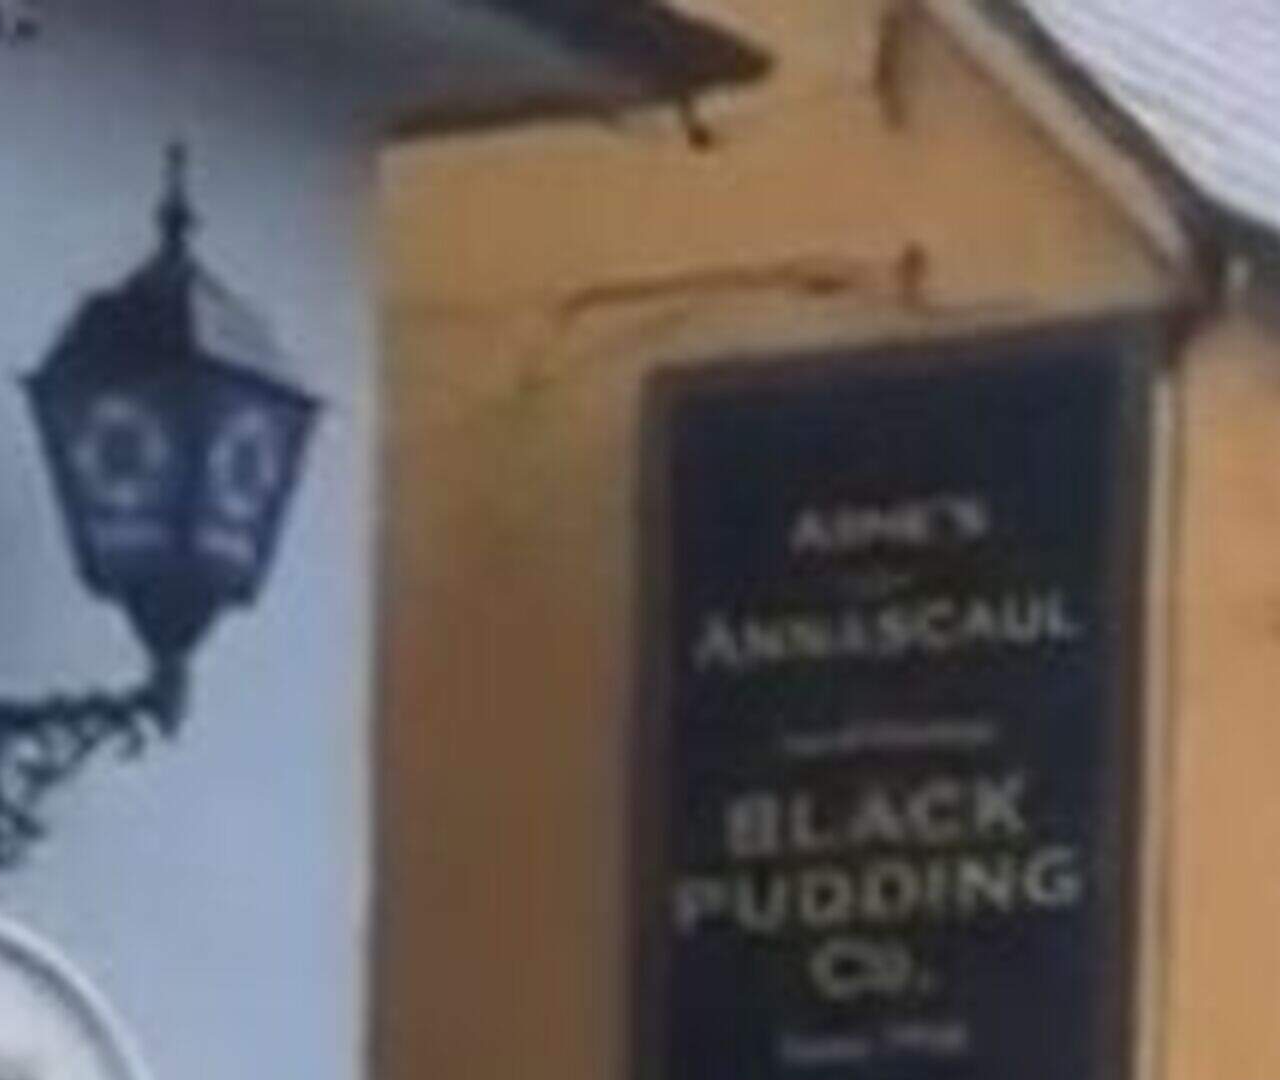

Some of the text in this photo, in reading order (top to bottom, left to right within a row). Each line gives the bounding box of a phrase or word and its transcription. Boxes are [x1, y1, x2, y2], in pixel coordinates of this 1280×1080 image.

[692, 590, 1084, 674] ANNASCAUL
[726, 772, 1026, 860] BLACK
[674, 846, 1083, 936] PUDDING
